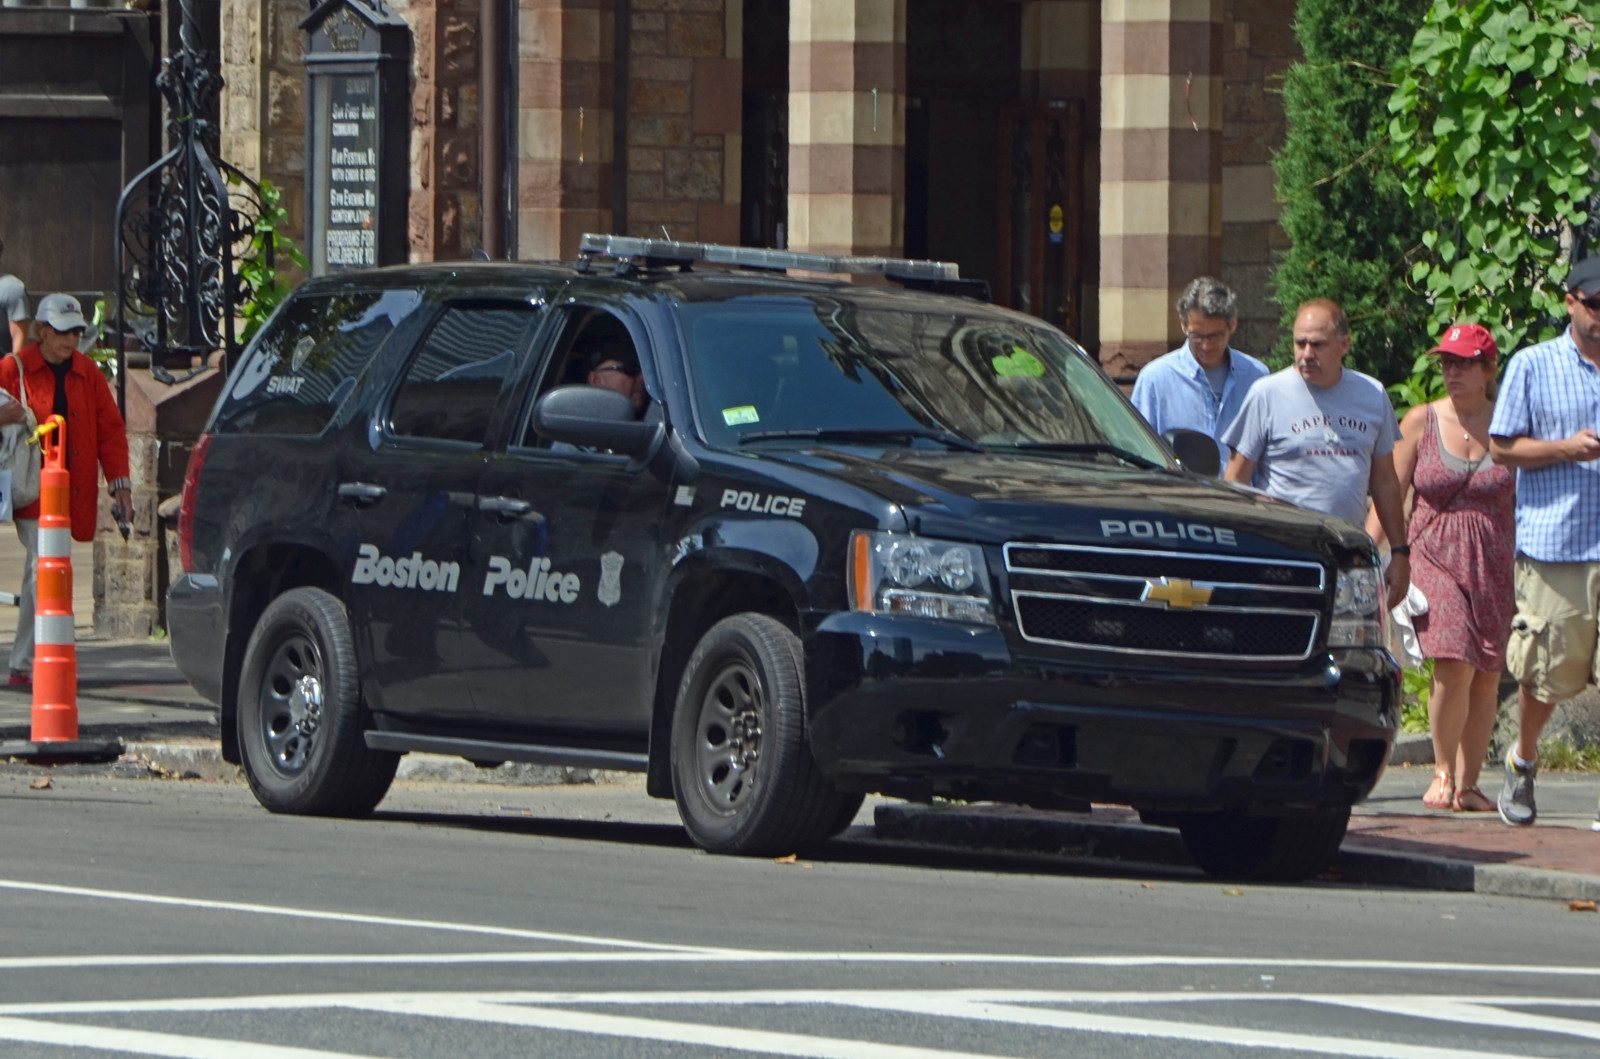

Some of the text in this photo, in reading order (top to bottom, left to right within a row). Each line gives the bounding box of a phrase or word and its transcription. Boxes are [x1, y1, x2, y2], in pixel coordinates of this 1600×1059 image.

[1448, 328, 1461, 342] B
[266, 375, 305, 394] SWAT
[1291, 414, 1368, 435] CAPE COD
[720, 488, 806, 518] POLICE
[1099, 519, 1237, 547] POLICE
[351, 543, 581, 604] Boston Police
